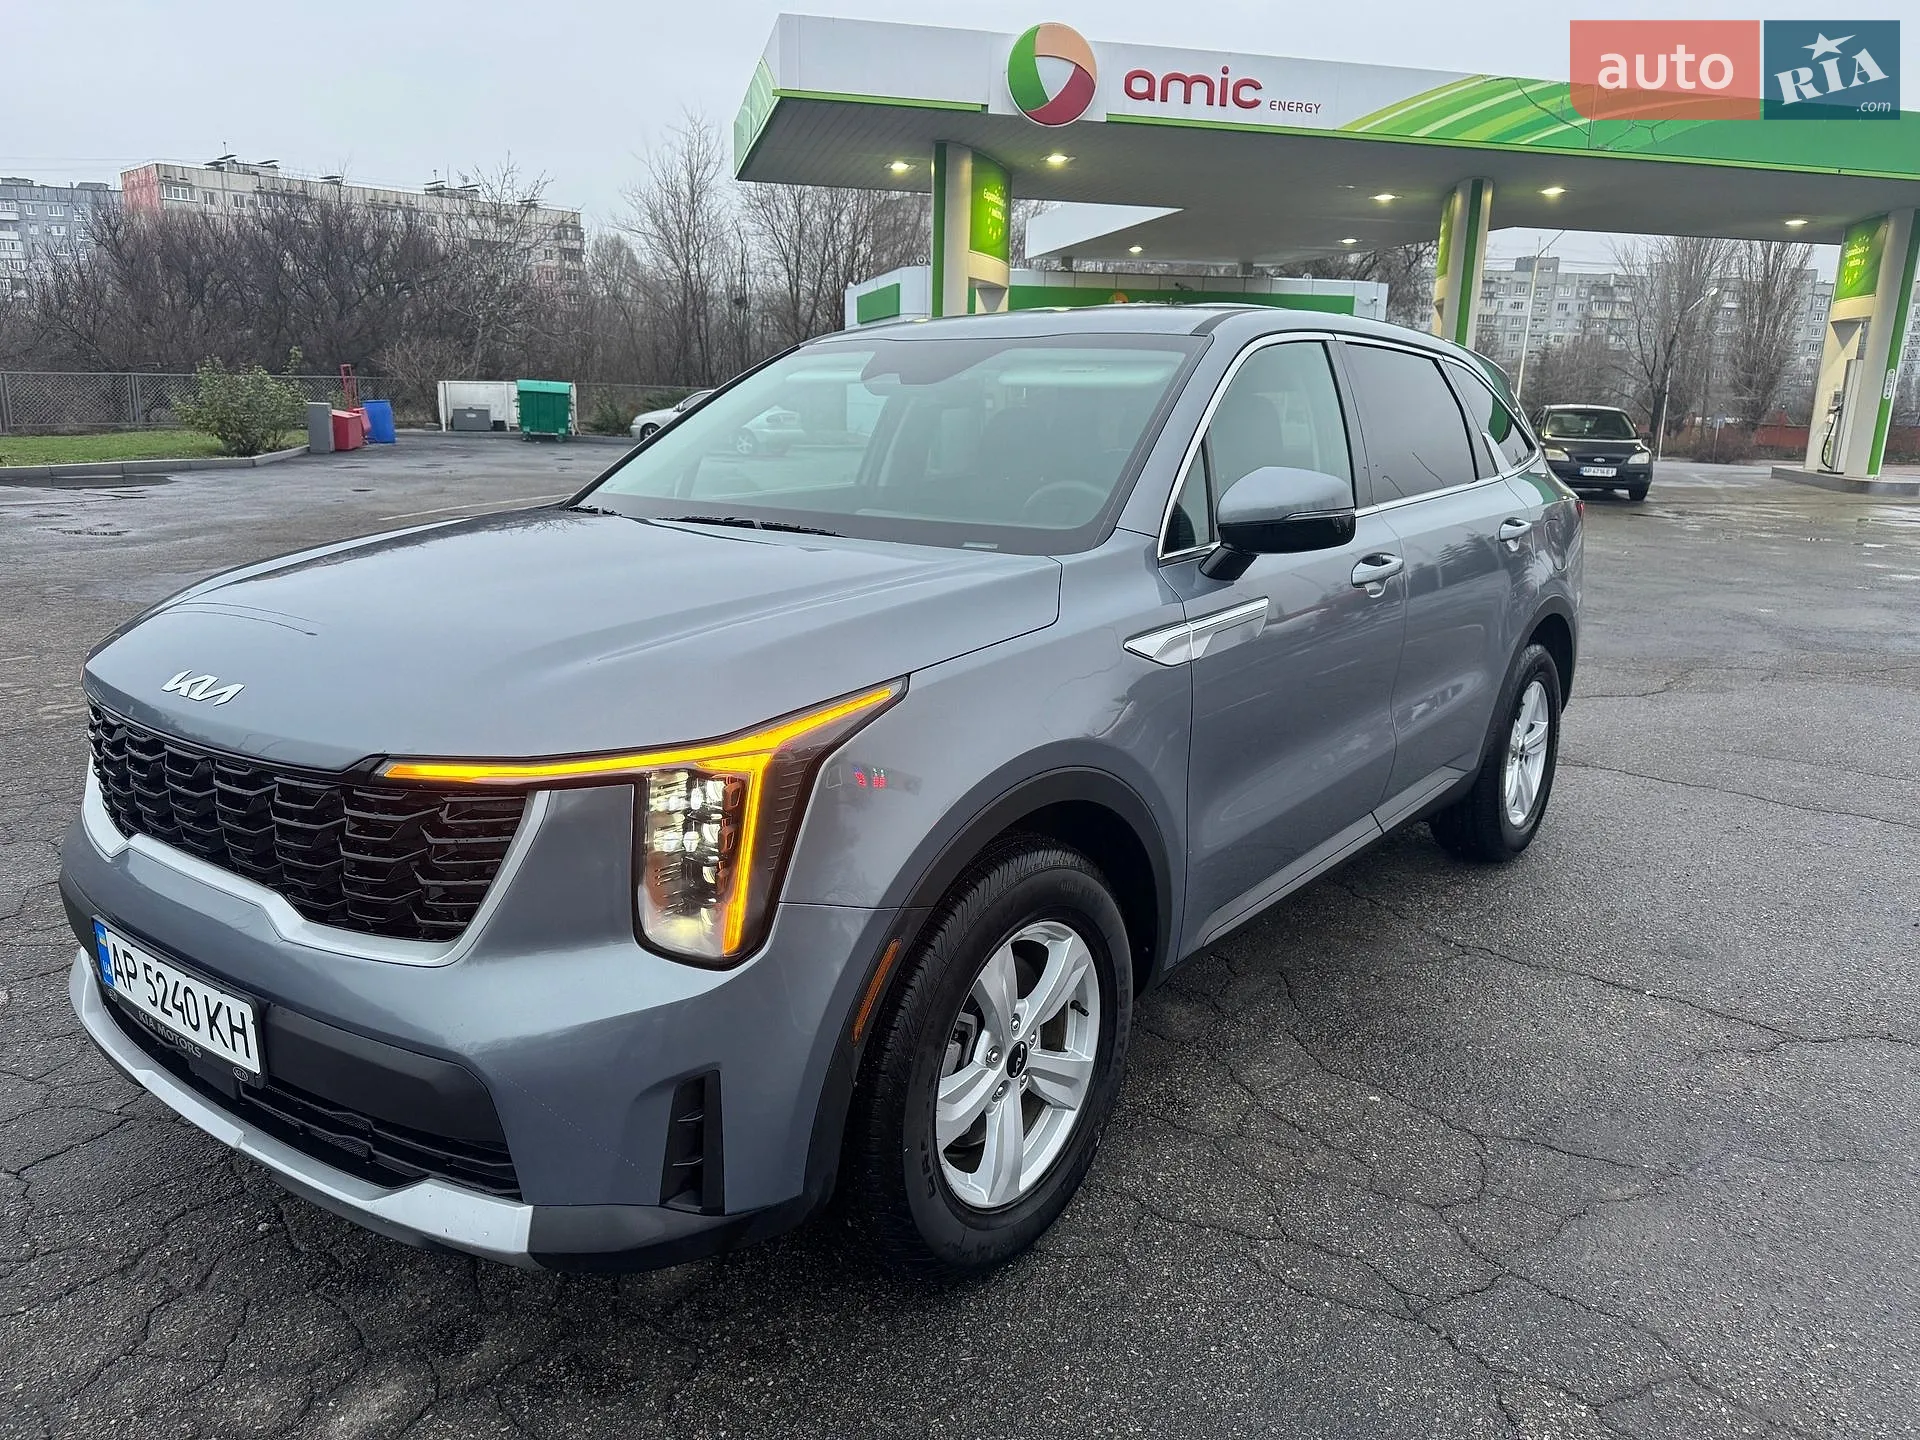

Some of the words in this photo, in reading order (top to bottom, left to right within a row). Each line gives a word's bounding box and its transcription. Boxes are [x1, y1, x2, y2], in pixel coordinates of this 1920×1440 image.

[1124, 65, 1263, 109] amic
[1269, 100, 1321, 114] ENERGY
[161, 669, 246, 707] KIA
[102, 960, 112, 977] UA
[112, 943, 138, 992] AP
[142, 961, 201, 1032] 5240
[203, 994, 251, 1059] KH
[138, 1010, 157, 1030] KIA
[156, 1025, 202, 1058] MOTORS
